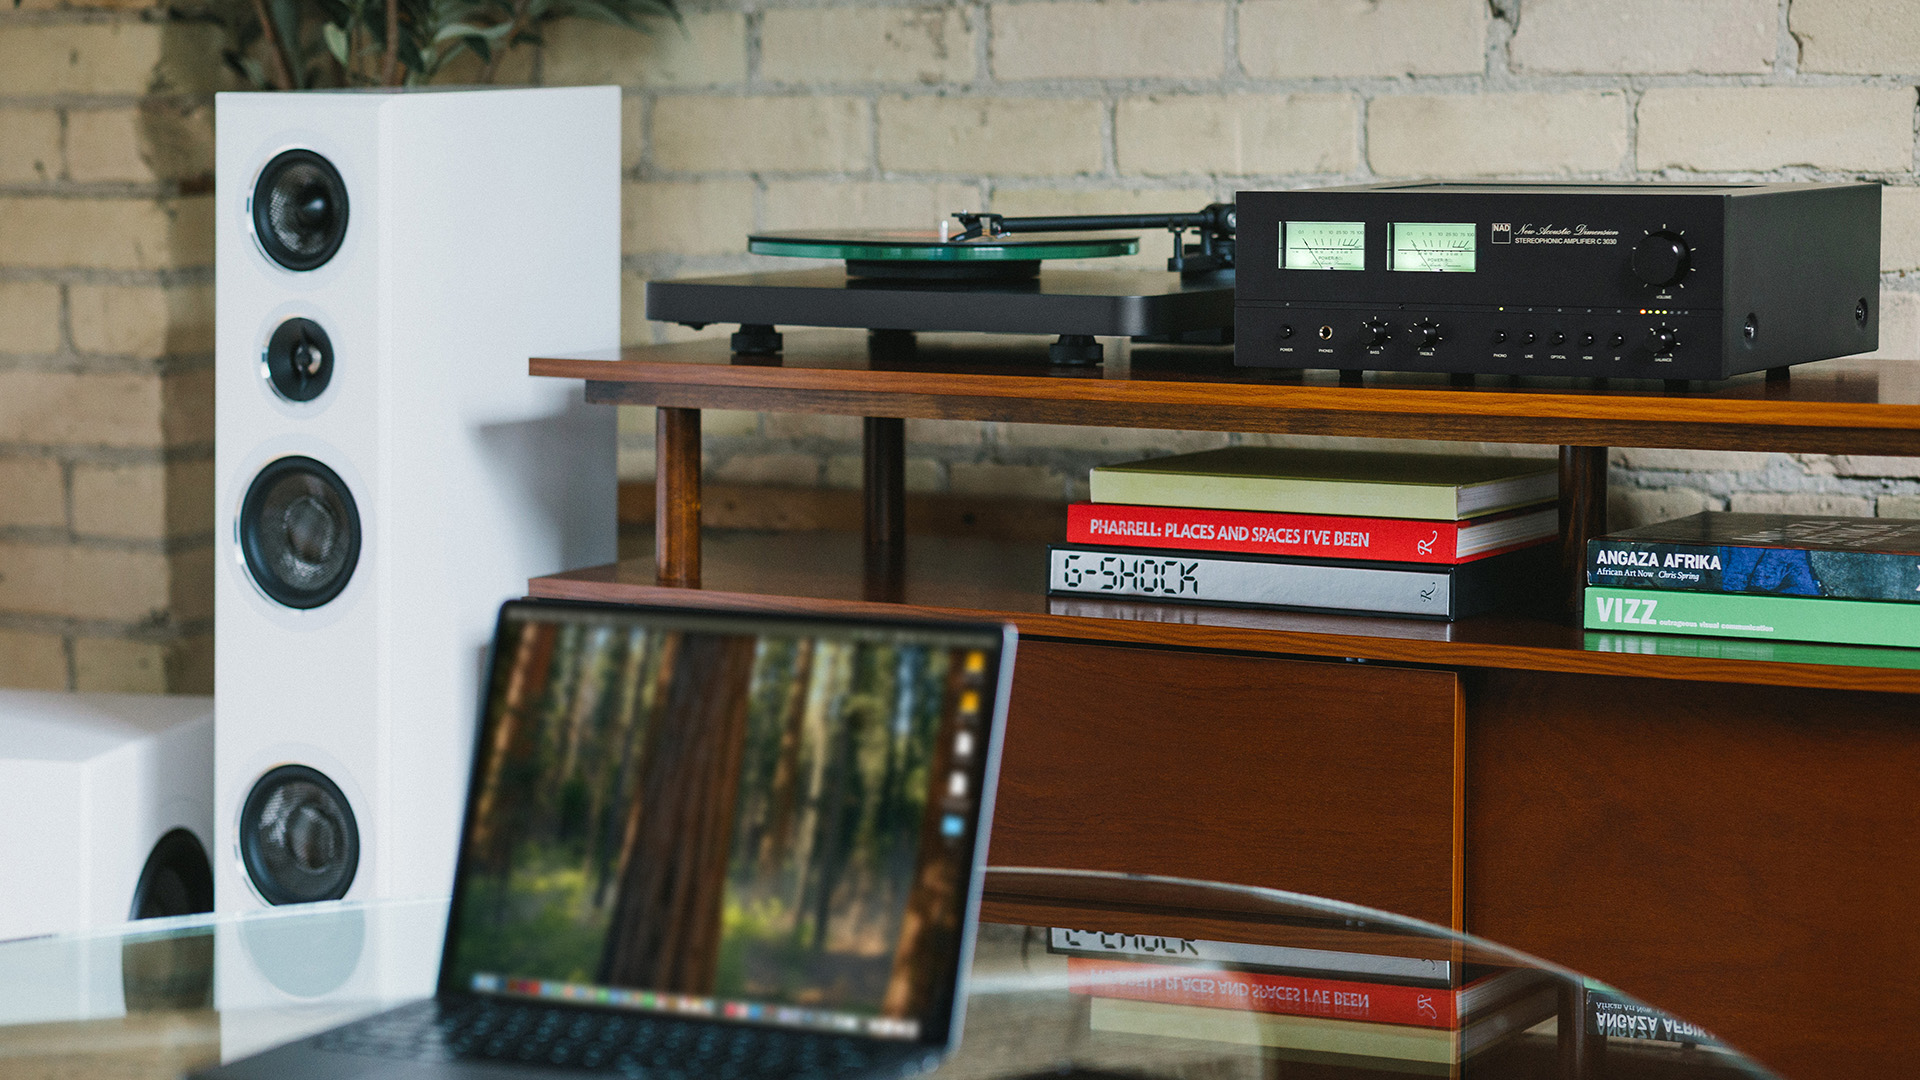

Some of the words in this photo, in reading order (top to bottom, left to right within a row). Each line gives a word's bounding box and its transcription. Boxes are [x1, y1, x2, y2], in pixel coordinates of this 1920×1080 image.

[1493, 224, 1510, 232] NAD
[1514, 223, 1535, 235] New
[1536, 224, 1572, 236] Acoustic
[1573, 223, 1619, 236] Dimension
[1090, 518, 1163, 537] PHARRELL:
[1165, 522, 1216, 540] PLACES
[1217, 525, 1249, 541] AND
[1251, 526, 1301, 545] SPACES
[1304, 529, 1331, 546] I'VE
[1334, 530, 1370, 548] BEEN
[1596, 549, 1659, 567] ANGAZA
[1663, 553, 1722, 570] AFRIKA
[1064, 555, 1199, 595] G-SHOCK
[1596, 567, 1623, 576] African
[1624, 569, 1636, 577] Art
[1637, 570, 1654, 578] Now
[1658, 570, 1677, 580] Chris
[1677, 571, 1700, 582] Spring
[1596, 597, 1658, 625] VIZZ
[1659, 619, 1698, 628] outrageous
[1699, 621, 1720, 629] visual
[1721, 623, 1774, 632] communication
